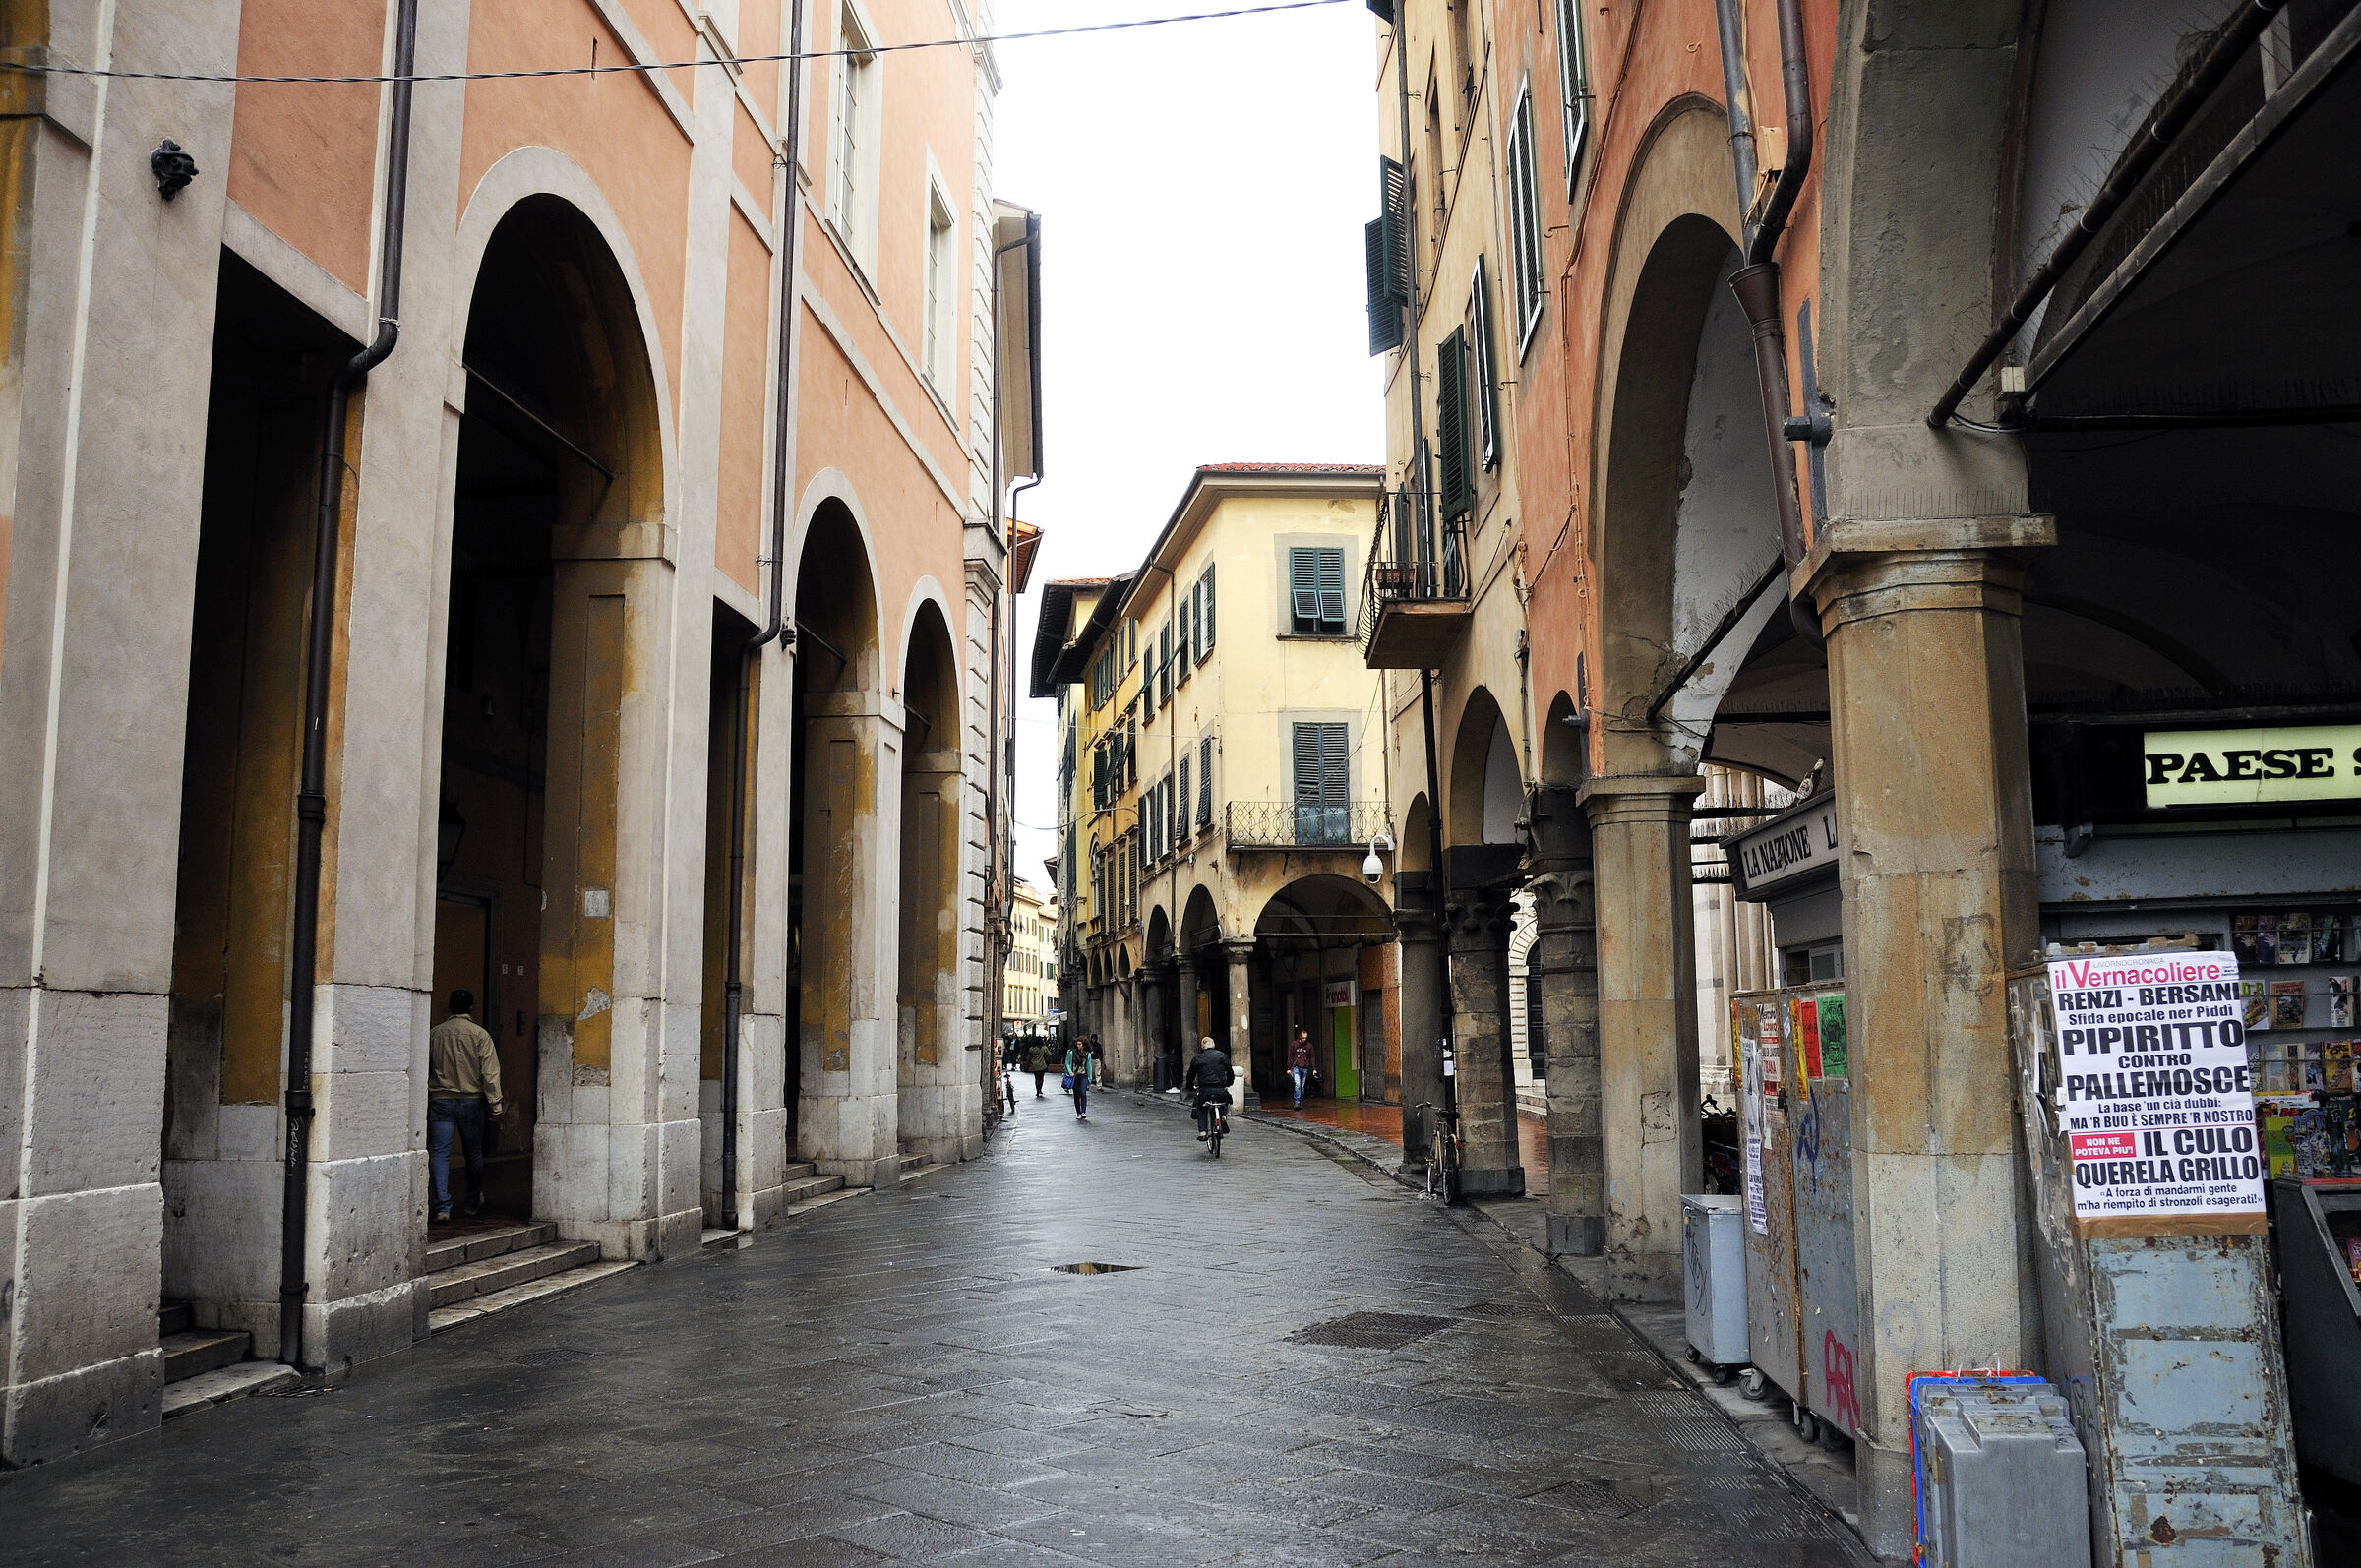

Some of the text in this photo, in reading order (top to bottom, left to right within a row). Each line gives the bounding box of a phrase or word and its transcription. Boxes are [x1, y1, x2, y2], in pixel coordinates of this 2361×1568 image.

[2146, 748, 2334, 784] PAESE
[1744, 846, 1762, 879] LA
[1759, 825, 1812, 874] NAZIONE
[2093, 957, 2165, 969] LIVORNOCRONACA
[2055, 969, 2066, 989] il
[2068, 960, 2220, 988] Vernacoliere
[2058, 990, 2122, 1011] RENZI
[2139, 982, 2240, 1007] BERSANI
[2069, 1004, 2233, 1025] Sfida epocale ner Piddì
[2062, 1019, 2244, 1055] PIPIRITTO
[2118, 1053, 2192, 1069] CONTRO
[2067, 1065, 2250, 1102] PALLEMOSCE
[2098, 1097, 2221, 1114] La base 'un cià dubbi:
[2070, 1109, 2253, 1130] MA 'R BUO È SEMPRE 'R NOSTRO
[2075, 1147, 2111, 1157] POTEVA
[2086, 1136, 2121, 1147] NON NE
[2143, 1126, 2253, 1157] IL CULO
[2075, 1155, 2259, 1189] QUERELA GRILLO
[2115, 1186, 2141, 1198] forza
[2143, 1185, 2152, 1196] di
[2155, 1183, 2205, 1196] mandarmi
[2208, 1183, 2237, 1196] gente
[2077, 1193, 2263, 1212] m'ha riempito di stronzoli esagerati!»
